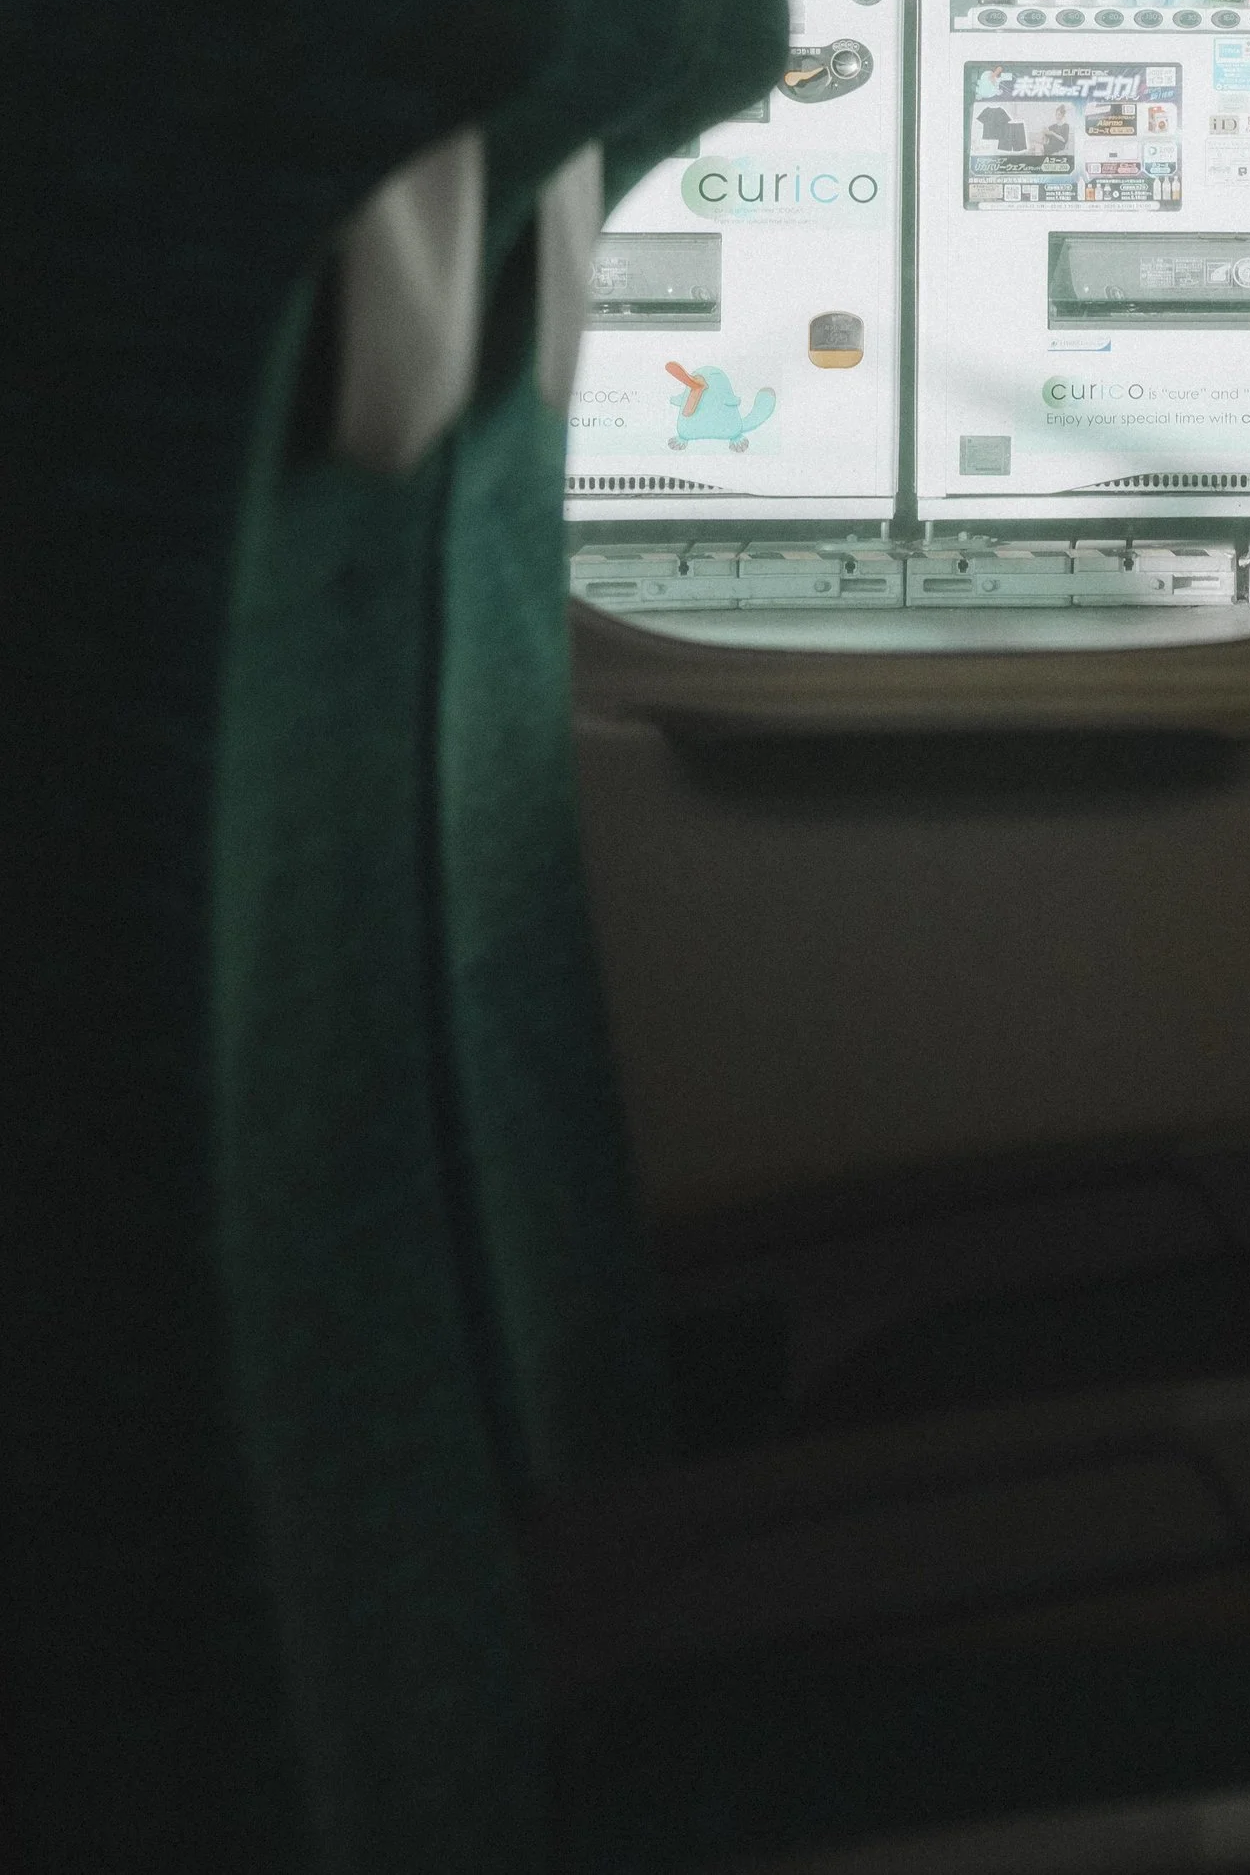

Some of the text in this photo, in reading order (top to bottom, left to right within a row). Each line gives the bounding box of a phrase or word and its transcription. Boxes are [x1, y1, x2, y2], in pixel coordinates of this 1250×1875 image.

[1213, 118, 1237, 130] iD
[698, 165, 878, 204] curico
[1050, 383, 1144, 401] curico
[1148, 387, 1157, 400] is
[1211, 387, 1239, 400] and
[1046, 413, 1081, 426] Enjoy
[1087, 415, 1118, 426] your
[1121, 412, 1171, 426] special
[1175, 412, 1205, 424] time
[1209, 412, 1237, 424] with
